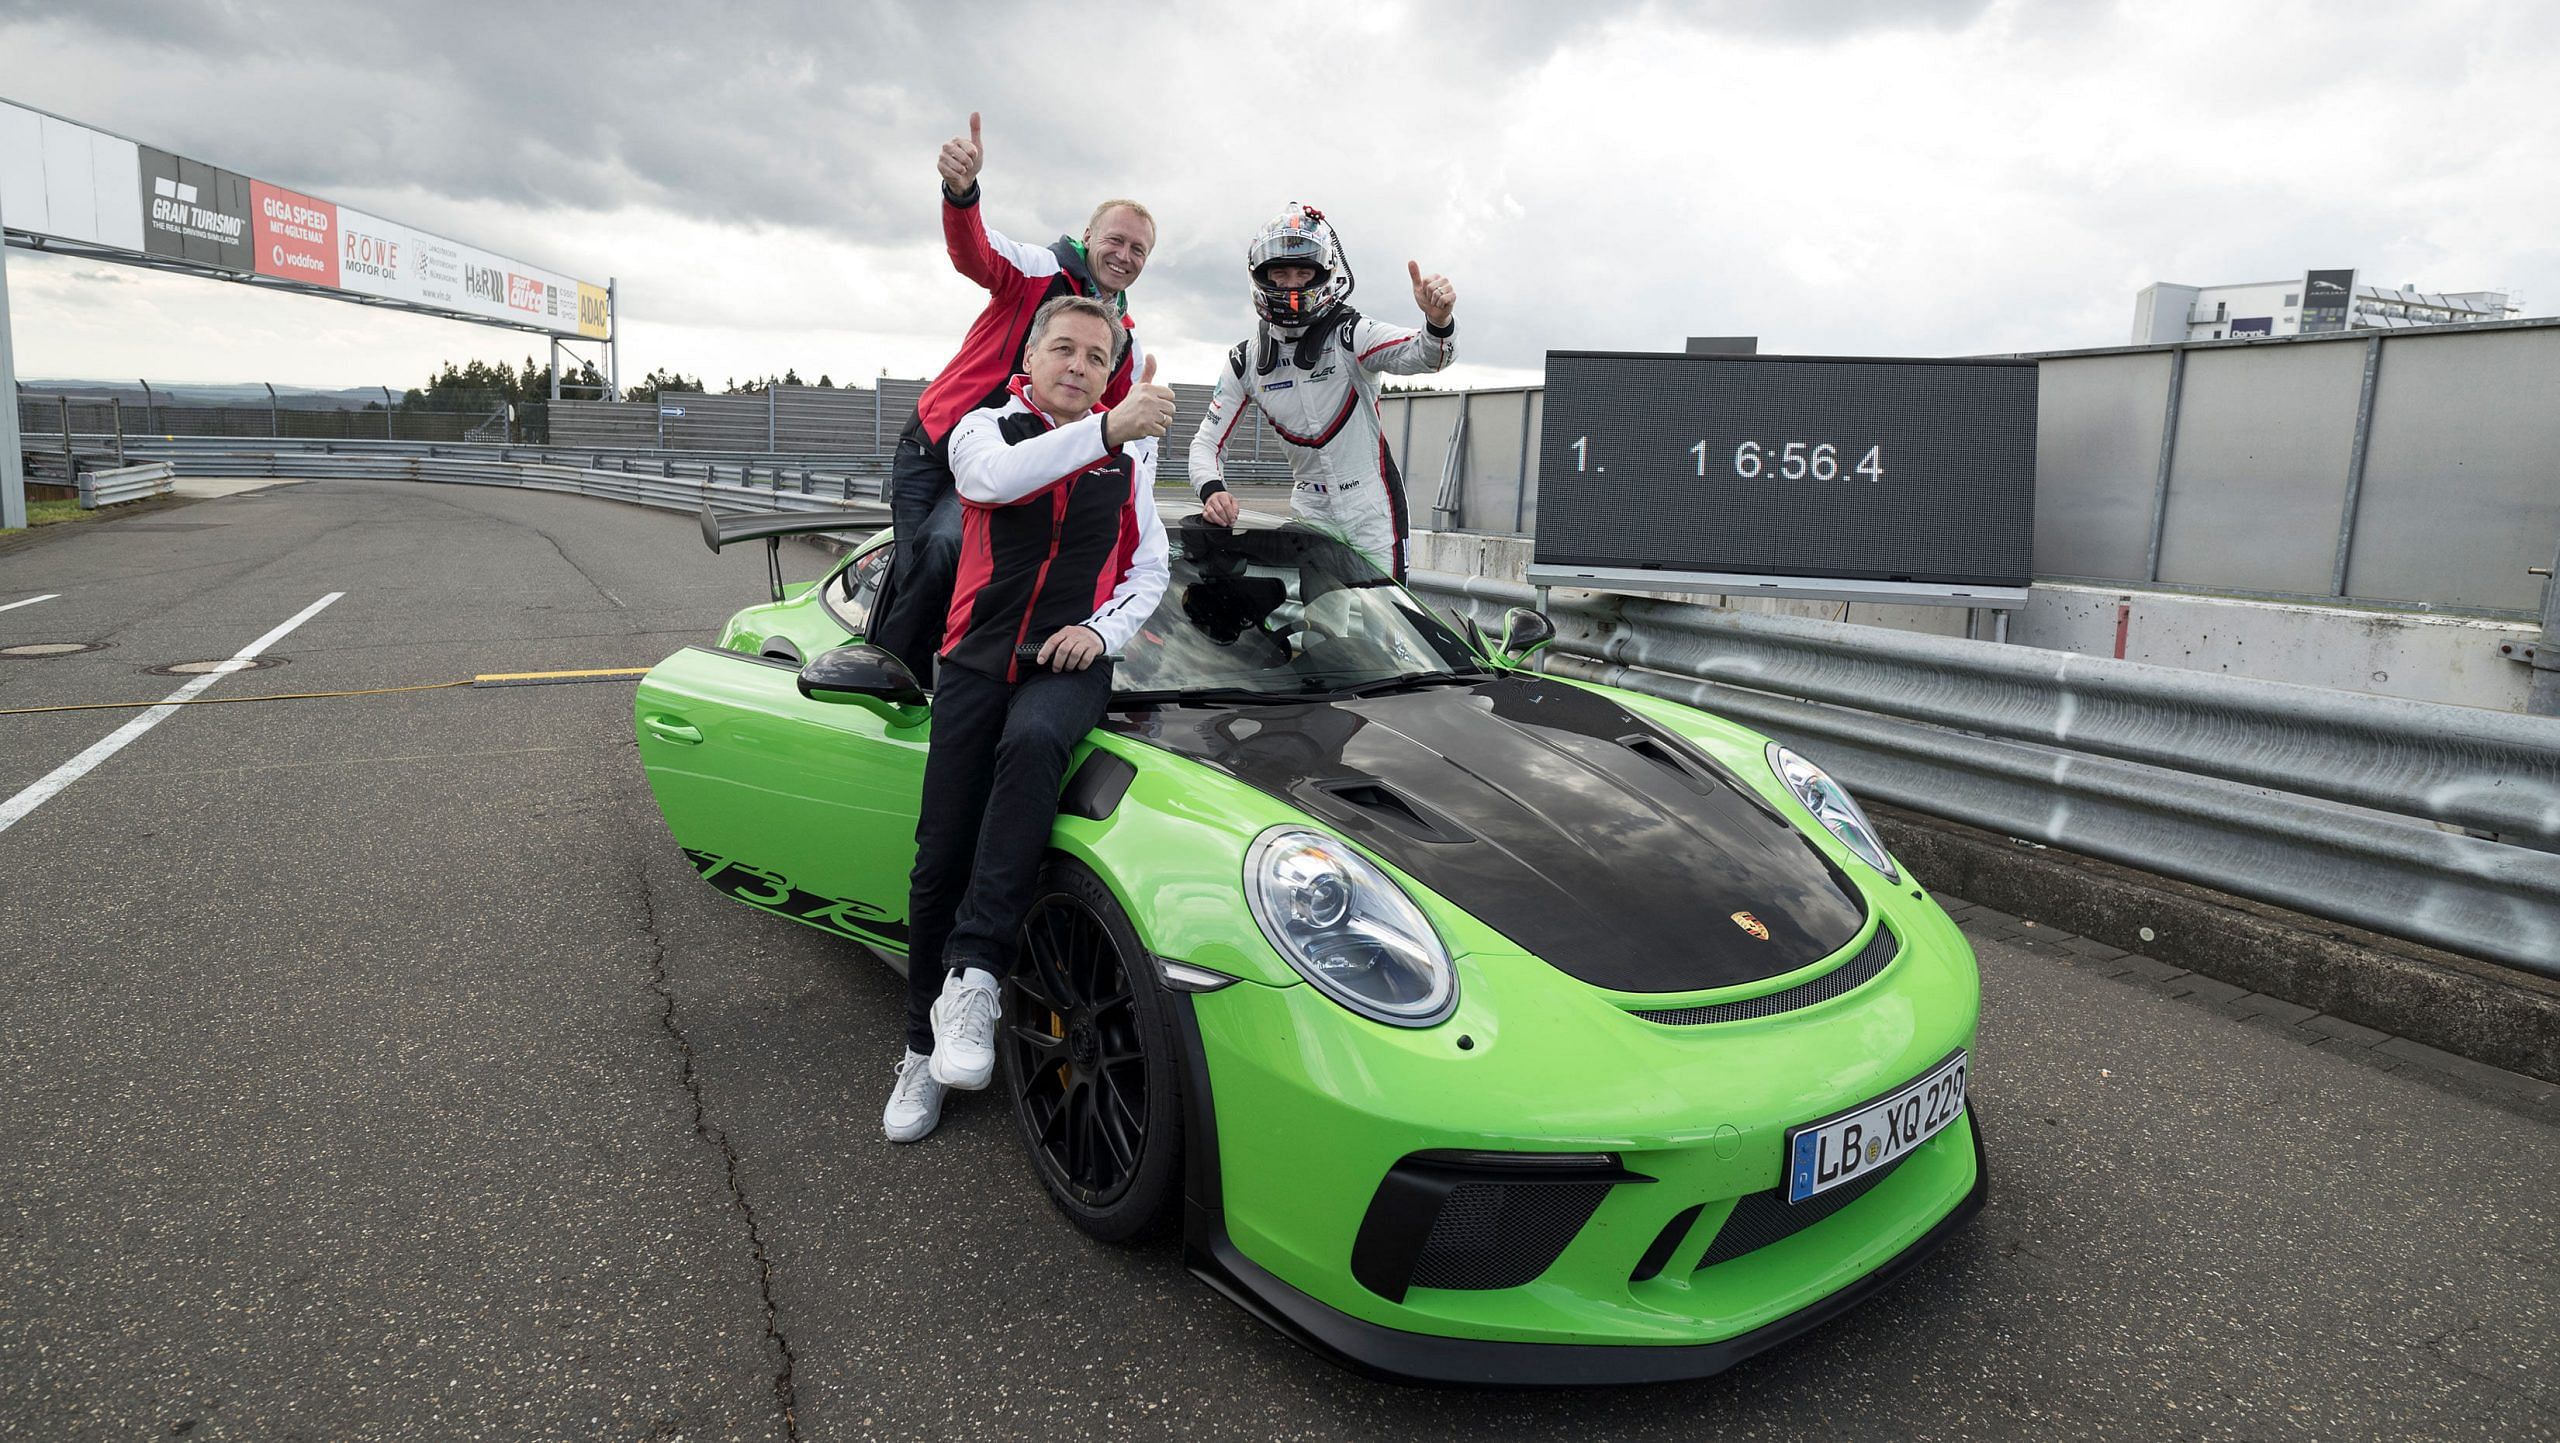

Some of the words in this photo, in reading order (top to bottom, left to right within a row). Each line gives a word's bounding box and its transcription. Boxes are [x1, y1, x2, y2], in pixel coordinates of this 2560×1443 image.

[152, 198, 188, 225] GRAN
[263, 197, 292, 222] GIGA
[293, 206, 328, 231] SPEED
[152, 220, 165, 231] THE
[166, 224, 181, 234] REAL
[182, 227, 207, 239] DRIVING
[207, 232, 240, 246] SIMULATOR
[270, 220, 284, 235] MIT
[308, 230, 324, 245] MAX
[286, 252, 325, 272] vodafone
[345, 232, 398, 269] ROWE
[345, 260, 379, 276] MOTOR
[382, 268, 396, 280] OIL
[465, 263, 490, 296] H&R
[510, 287, 543, 312] auto
[581, 295, 605, 327] ADAC
[1571, 436, 1605, 472] 1.
[1690, 439, 1707, 476] 1
[1735, 441, 1885, 482] 6:56.4
[1817, 1123, 1863, 1185] LB
[1884, 1095, 1921, 1157] XQ
